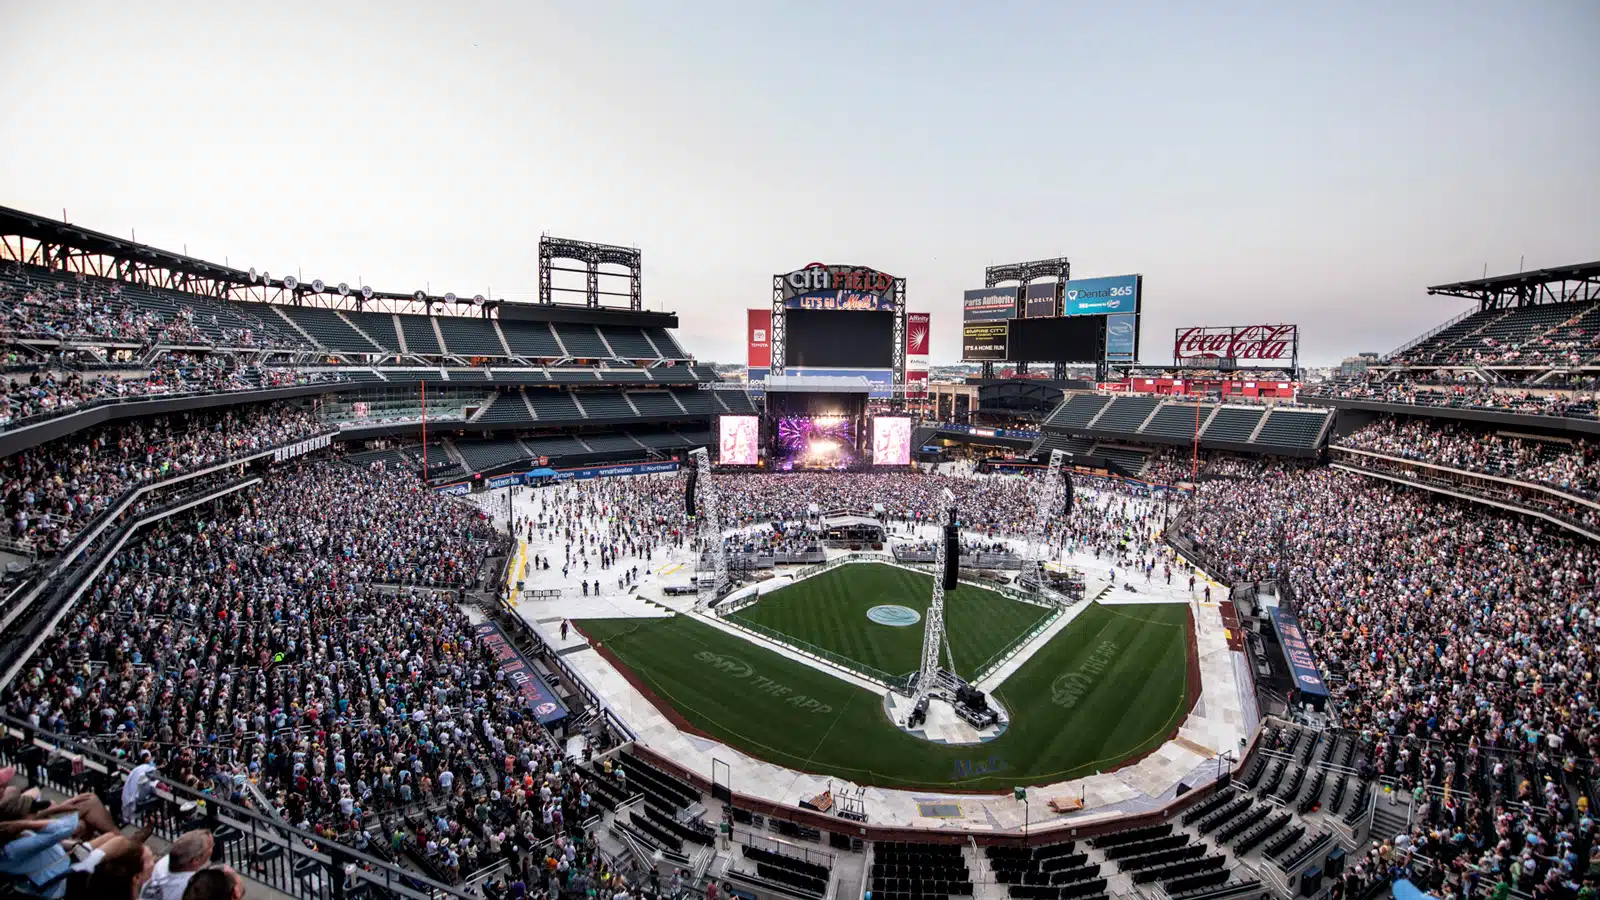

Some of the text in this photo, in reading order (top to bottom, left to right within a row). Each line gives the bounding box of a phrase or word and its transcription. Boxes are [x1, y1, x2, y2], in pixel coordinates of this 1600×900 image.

[832, 271, 891, 291] FIELD
[800, 297, 822, 309] LET'S
[824, 297, 835, 308] GO
[843, 294, 873, 309] Mets
[964, 298, 982, 307] Parts
[982, 294, 1015, 305] Authority
[908, 315, 929, 323] Affinity
[599, 467, 634, 475] smartwater
[646, 464, 673, 472] Northwell
[750, 675, 793, 697] THE
[785, 695, 833, 714] APP
